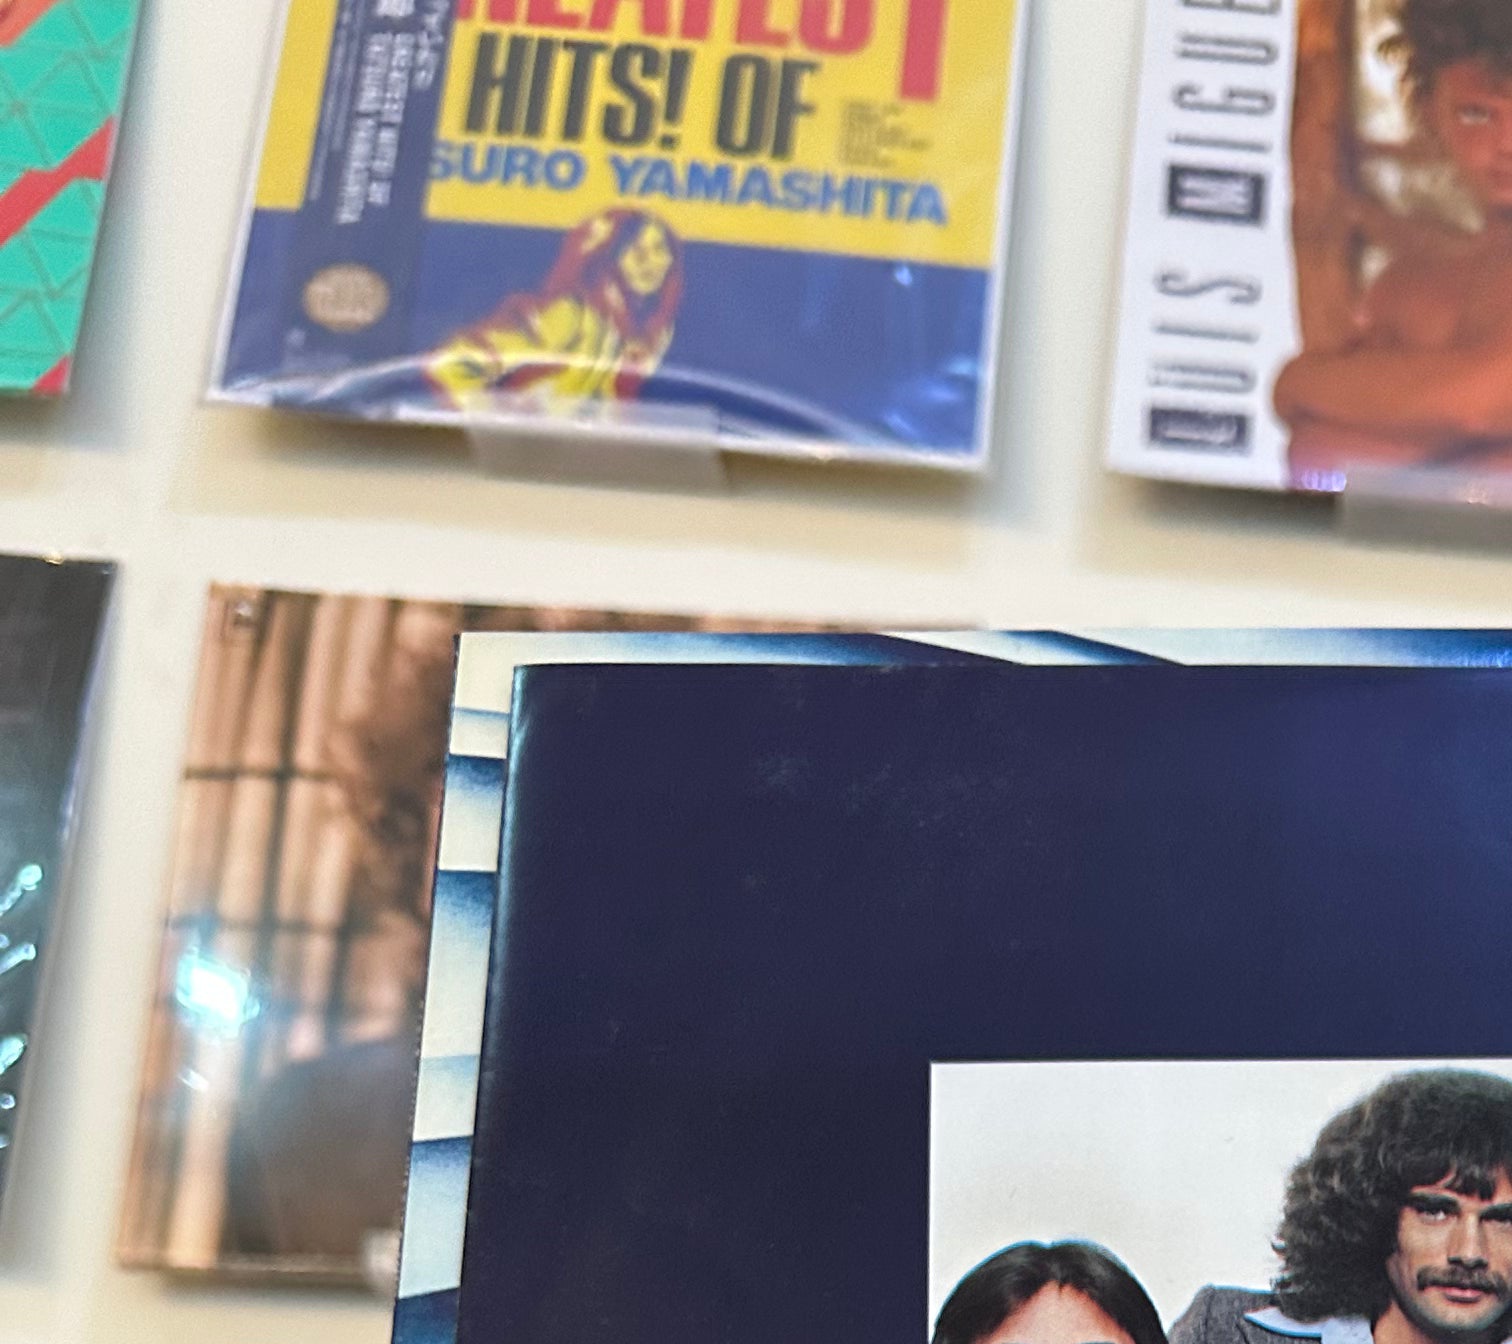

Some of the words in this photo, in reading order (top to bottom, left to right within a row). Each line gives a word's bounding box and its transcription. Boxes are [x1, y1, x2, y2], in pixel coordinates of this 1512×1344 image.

[462, 31, 696, 152] HITS!
[711, 51, 823, 161] OF
[607, 152, 949, 228] YAMASHITA
